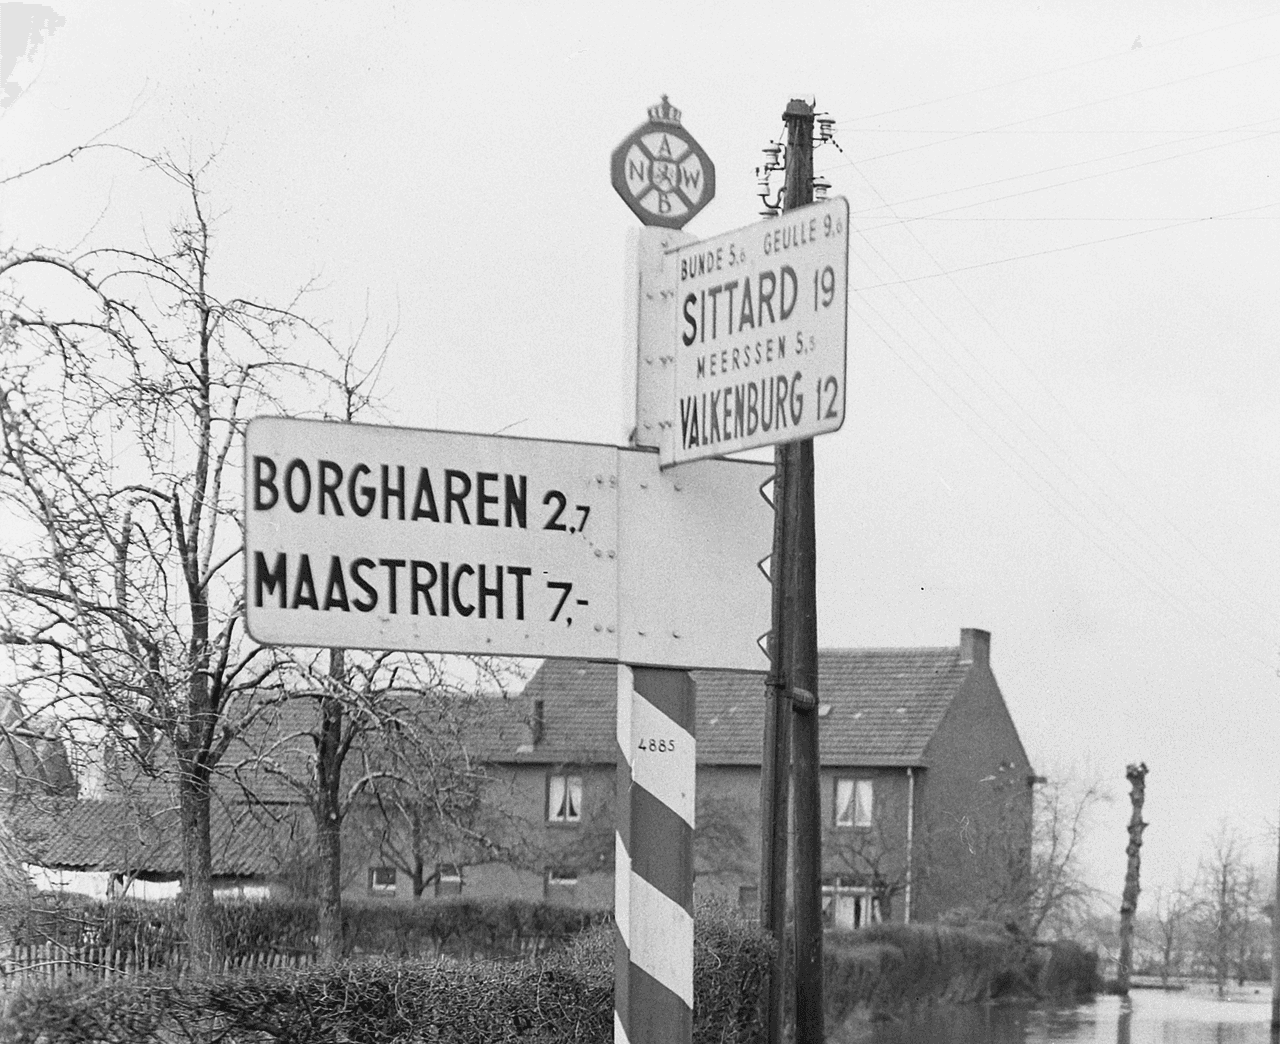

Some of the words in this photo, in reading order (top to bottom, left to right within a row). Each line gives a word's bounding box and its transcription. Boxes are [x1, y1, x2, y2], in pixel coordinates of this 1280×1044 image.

[680, 247, 724, 281] BUNDE
[763, 218, 818, 256] GEULLE
[682, 264, 799, 347] SITTARD
[813, 265, 836, 312] 19
[696, 334, 786, 379] MEERSSEN
[680, 371, 804, 450] VALKENBURG
[816, 376, 839, 421] 12
[253, 455, 527, 530] BORGHAREN
[253, 550, 532, 622] MAASTRICHT
[638, 738, 675, 752] 4885
